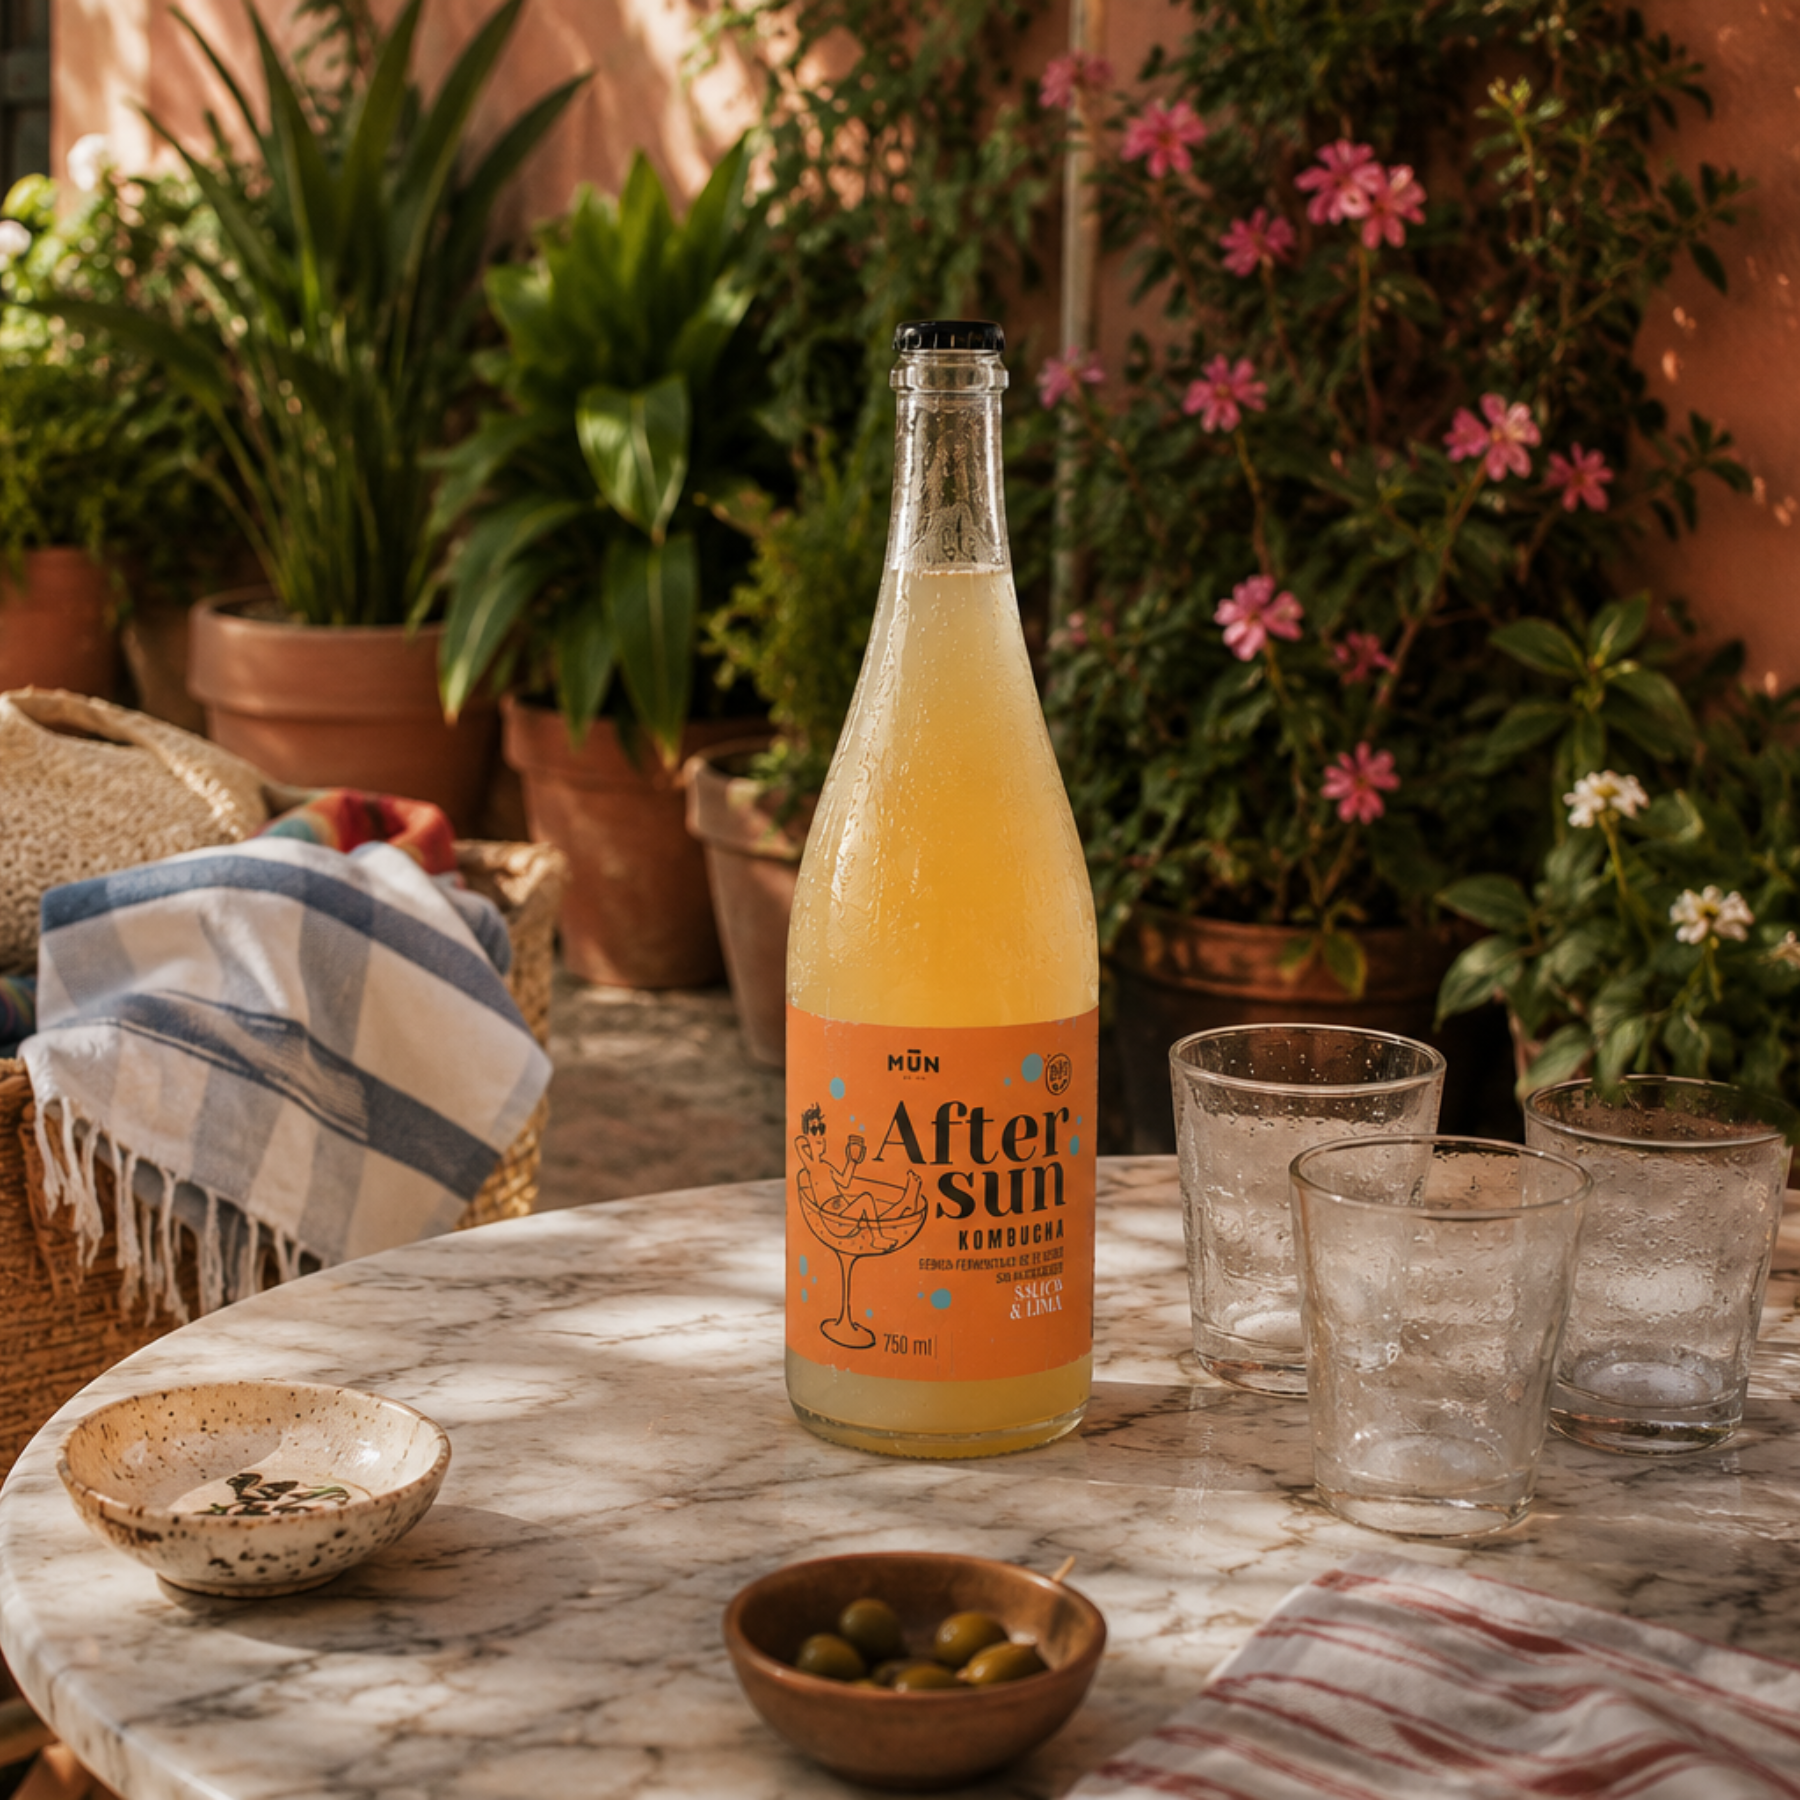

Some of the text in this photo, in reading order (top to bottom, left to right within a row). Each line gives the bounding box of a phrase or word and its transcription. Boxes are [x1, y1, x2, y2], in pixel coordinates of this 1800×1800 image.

[888, 1049, 940, 1073] MŪN
[872, 1100, 1069, 1165] After
[936, 1162, 1066, 1219] sun
[959, 1219, 1064, 1250] KOMBUCHA
[1010, 1294, 1063, 1320] & LIMA
[883, 1333, 932, 1356] 750 ml
